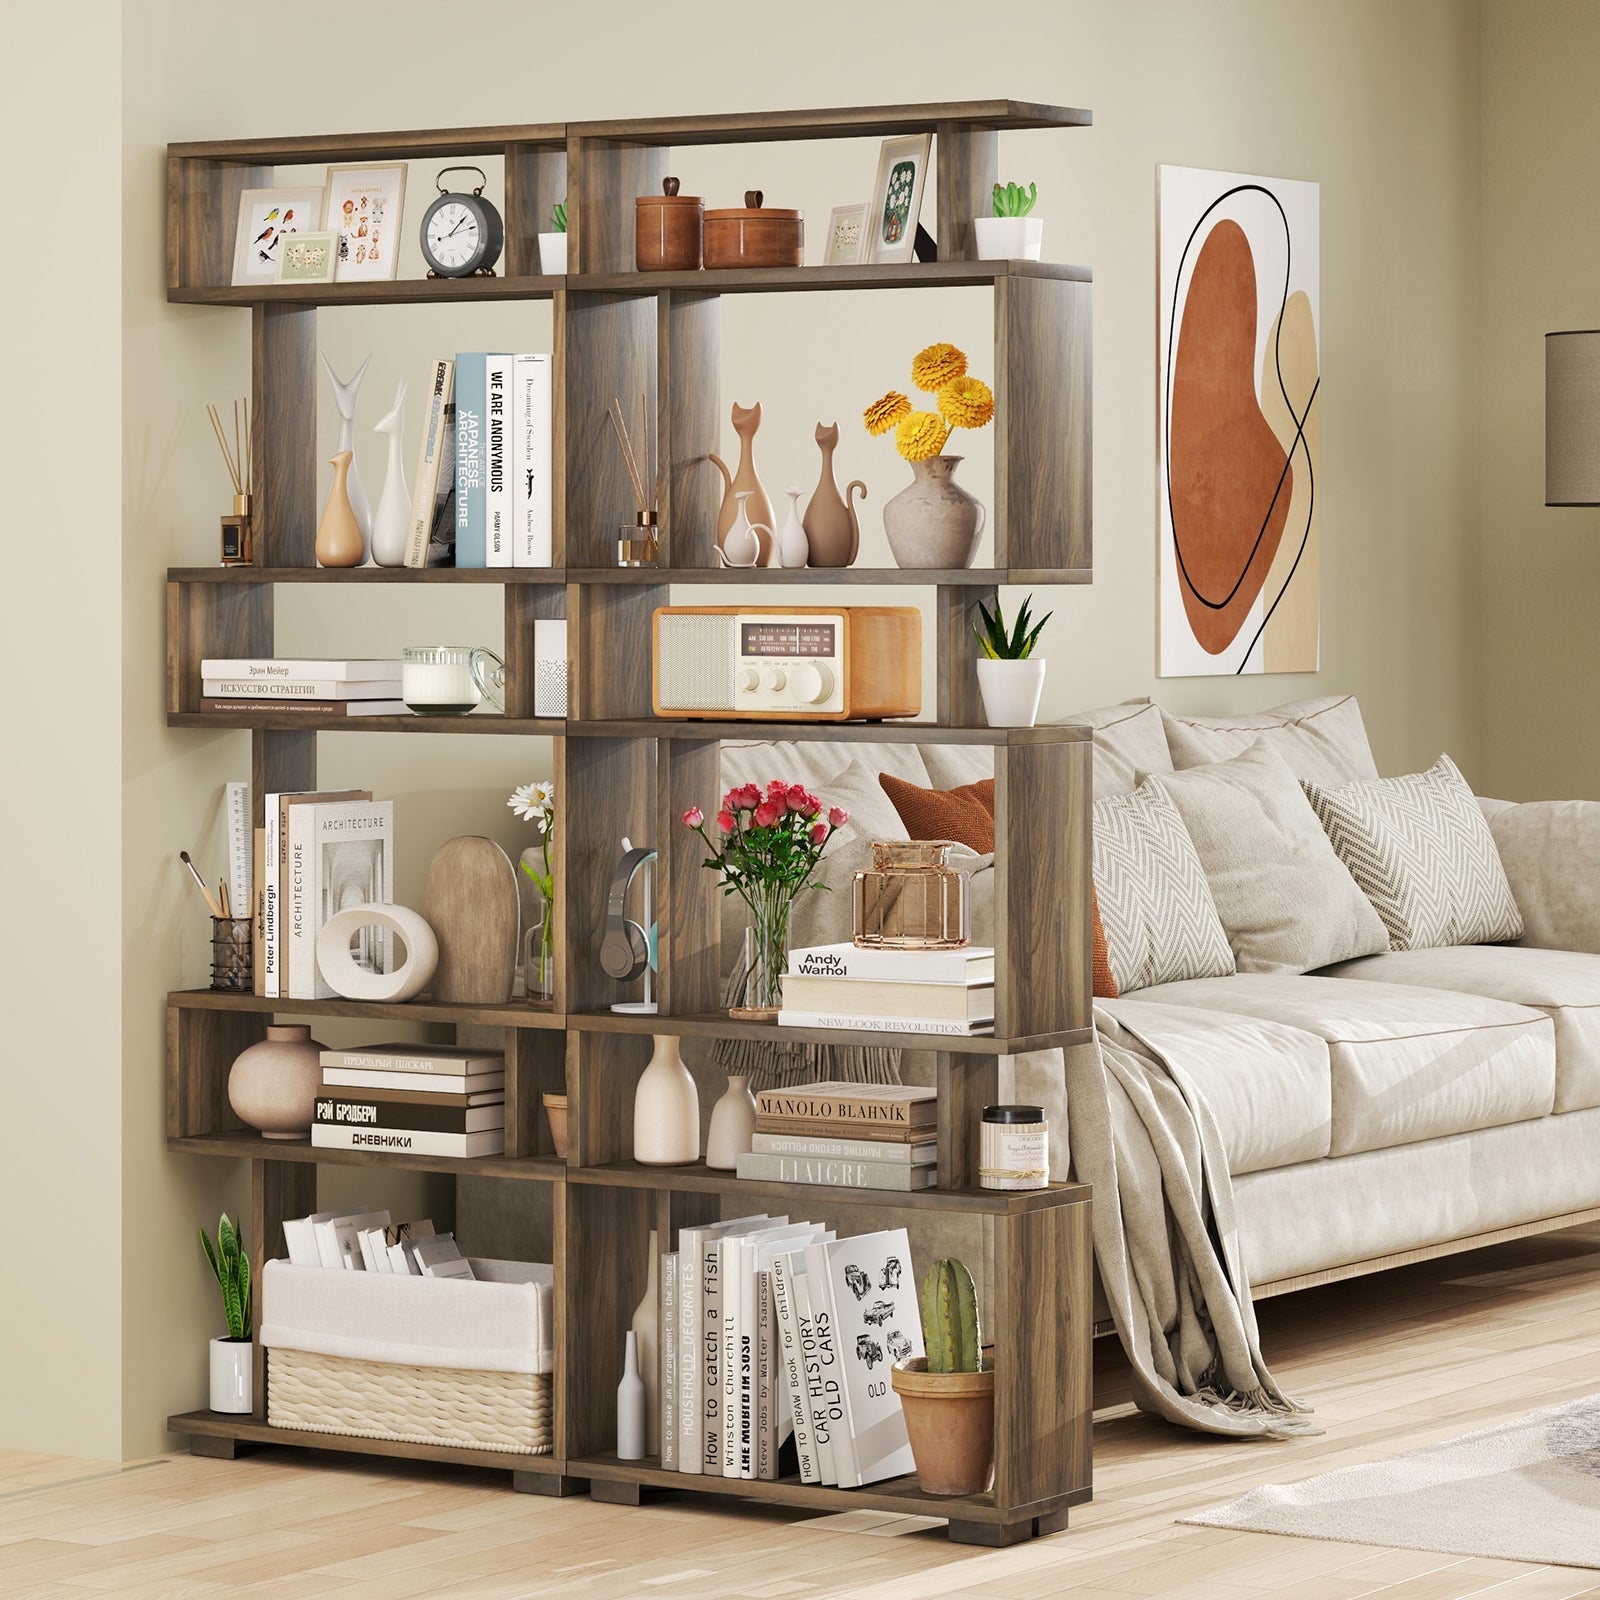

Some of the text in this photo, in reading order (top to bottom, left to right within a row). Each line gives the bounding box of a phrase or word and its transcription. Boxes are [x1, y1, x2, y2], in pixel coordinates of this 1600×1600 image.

[525, 378, 534, 460] Dreaming of Sweden
[490, 371, 503, 493] WE ARE ANONYMOUS
[467, 410, 479, 488] JAPANESE
[458, 410, 468, 528] ARCHITECTURE
[493, 511, 501, 553] PARMY OLSON
[249, 665, 289, 676] Эрин Мейер
[220, 684, 315, 694] ИСКУССТВО СТРАТЕГИИ
[322, 817, 384, 830] ARCHITECTURE
[294, 844, 302, 938] ARCHITECTURE
[266, 884, 276, 974] Peter Lindbergh
[798, 964, 847, 976] Warhol
[804, 954, 842, 968] Andy
[817, 1017, 962, 1034] NEW LOOK REVOLUTION
[344, 1056, 392, 1068] ПРЕМУДРЫЙ
[317, 1100, 377, 1123] РЭЙ БРЭДБЕРИ
[759, 1098, 906, 1121] MANOLO BLAHNÍK
[352, 1133, 412, 1148] ДНЕВНИКИ
[770, 1140, 807, 1152] POLLOCK
[810, 1142, 842, 1155] BEYOND
[844, 1144, 881, 1158] PAINTING
[780, 1159, 868, 1186] LIAIGRE
[666, 1312, 672, 1320] in
[666, 1327, 674, 1384] arrangement
[682, 1263, 694, 1436] HOUSEHOLD DECORATES
[704, 1252, 718, 1465] How to catch a fish
[760, 1274, 770, 1474] Steve Jobs by Walter Isaacson
[774, 1260, 812, 1478] HOW TO DRAW Book for children
[815, 1312, 843, 1420] OLD CARS
[725, 1316, 734, 1466] Winston Churchill
[798, 1316, 830, 1444] CAR HISTORY
[868, 1381, 886, 1398] OLD
[666, 1388, 672, 1400] an
[666, 1430, 672, 1440] to
